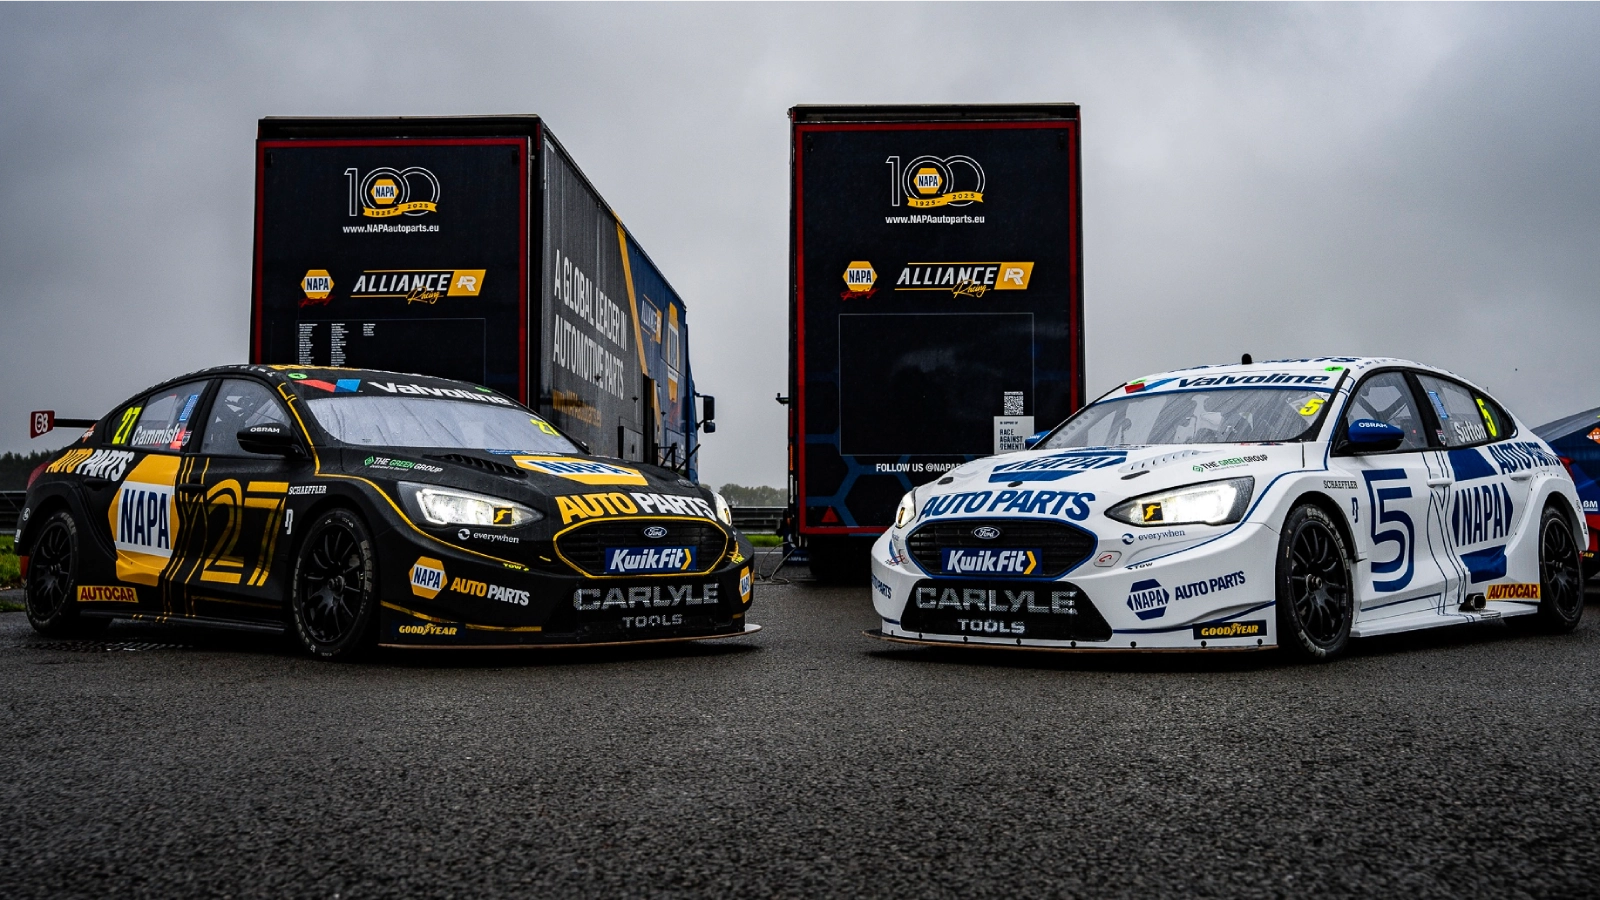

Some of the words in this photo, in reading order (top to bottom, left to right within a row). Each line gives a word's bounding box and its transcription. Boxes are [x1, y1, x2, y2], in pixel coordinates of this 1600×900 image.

[918, 175, 938, 187] NAPA
[375, 186, 395, 198] NAPA
[343, 224, 440, 234] www.NAPAautoparts.eu
[885, 215, 985, 225] www.NAPAautoparts.eu
[306, 277, 329, 290] NAPA
[352, 274, 451, 292] ALLIANCE
[848, 270, 872, 283] NAPA
[896, 266, 997, 285] ALLIANCE
[554, 249, 561, 299] A
[563, 256, 594, 326] GLOBAL
[595, 287, 620, 347] LEADER
[620, 310, 627, 351] IN
[553, 313, 603, 389] AUTOMOTIVE
[605, 350, 624, 400] PARTS
[1179, 373, 1329, 387] Valvoline
[368, 381, 515, 407] Valvoline
[1299, 398, 1326, 416] 5
[112, 406, 142, 445] 27
[1476, 398, 1497, 437] 5
[132, 422, 180, 446] Cammish
[1453, 420, 1487, 443] Sutton
[45, 448, 93, 473] AUTO
[75, 449, 134, 481] PARTS
[374, 457, 390, 465] THE
[389, 459, 416, 468] GREEN
[413, 463, 443, 473] GROUP
[876, 463, 910, 472] FOLLOW
[912, 463, 924, 472] US
[1200, 461, 1219, 469] THE
[1218, 457, 1245, 466] GREEN
[1243, 454, 1268, 463] GROUP
[288, 485, 327, 495] SCHAEFFLER
[1323, 480, 1358, 490] SCHAEFFLER
[555, 492, 638, 524] AUTO
[629, 492, 717, 522] PARTS
[917, 490, 993, 523] AUTO
[988, 489, 1096, 521] PARTS
[120, 488, 170, 550] NAPA
[1461, 484, 1503, 547] NAPA
[200, 478, 289, 587] 27
[473, 531, 520, 543] everywhen
[646, 527, 665, 537] Ford
[977, 527, 997, 538] Ford
[1138, 530, 1185, 542] everywhen
[1362, 468, 1415, 592] 5
[413, 567, 441, 589] NAPA
[1175, 581, 1209, 600] AUTO
[1209, 571, 1246, 593] PARTS
[80, 587, 136, 601] AUTOCAR
[450, 577, 488, 597] AUTO
[487, 584, 530, 606] PARTS
[573, 583, 719, 610] CARLYLE
[1132, 588, 1164, 611] NAPA
[1488, 584, 1539, 600] AUTOCAR
[916, 587, 1078, 615] CARLYLE
[622, 613, 683, 628] TOOLS
[957, 618, 1026, 634] TOOLS
